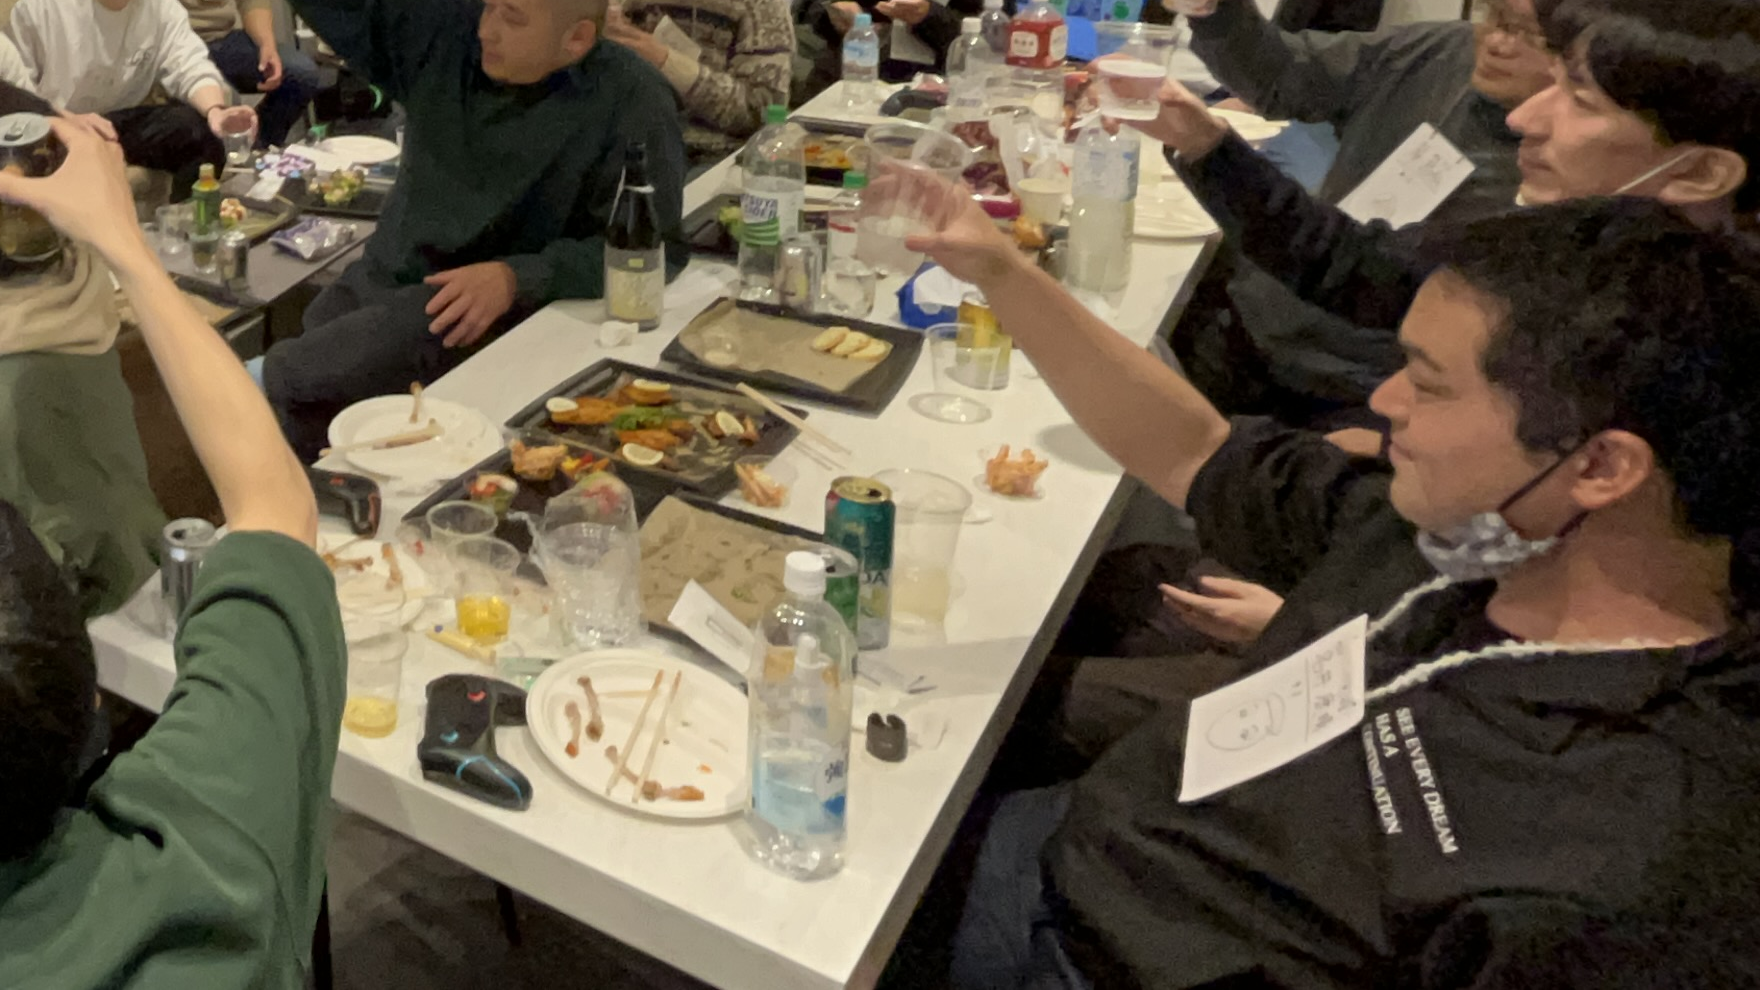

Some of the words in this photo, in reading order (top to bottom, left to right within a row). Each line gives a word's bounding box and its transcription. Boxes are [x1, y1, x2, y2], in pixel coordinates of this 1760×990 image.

[1376, 713, 1397, 744] HAS
[1382, 745, 1400, 758] A
[1405, 737, 1436, 788] EVERY
[1423, 791, 1459, 854] DREAM
